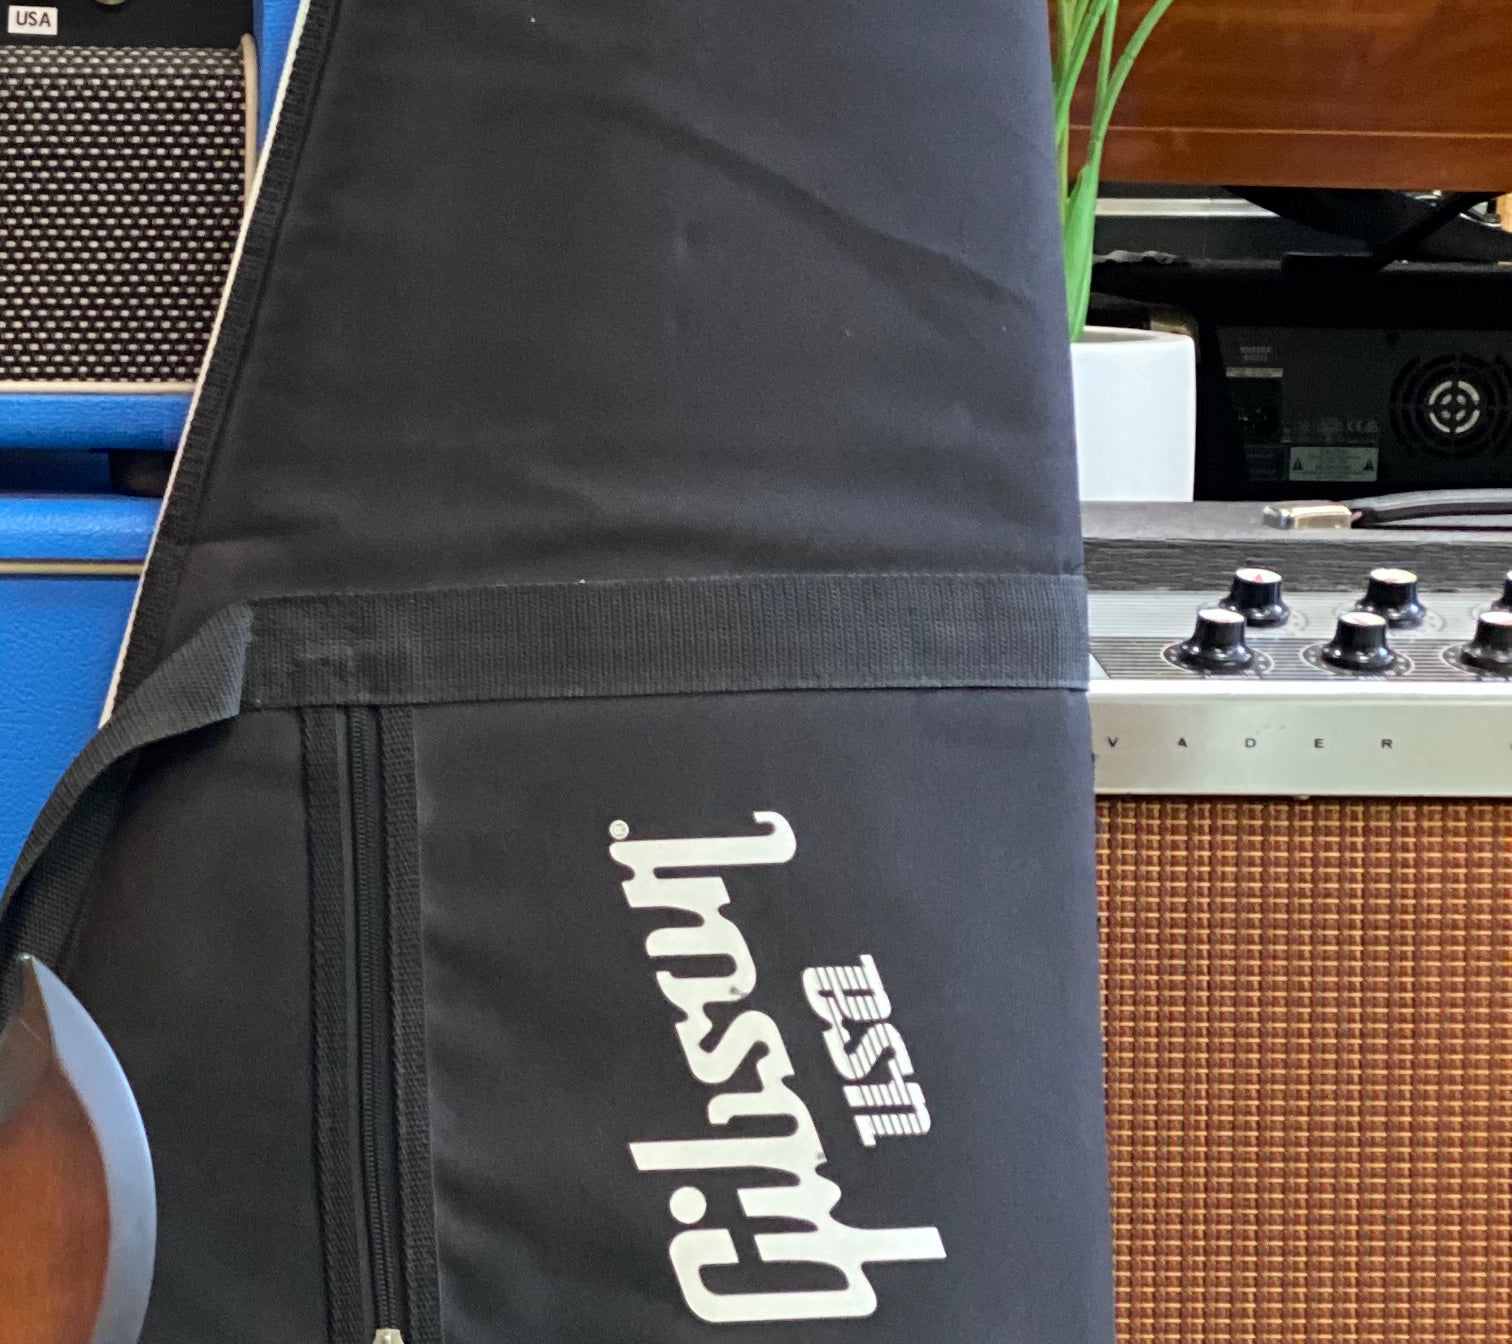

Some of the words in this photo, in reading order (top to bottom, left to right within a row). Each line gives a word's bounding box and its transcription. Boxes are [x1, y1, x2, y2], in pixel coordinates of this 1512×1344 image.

[16, 10, 52, 28] USA
[608, 810, 947, 1323] Gibson
[802, 954, 932, 1147] USA
